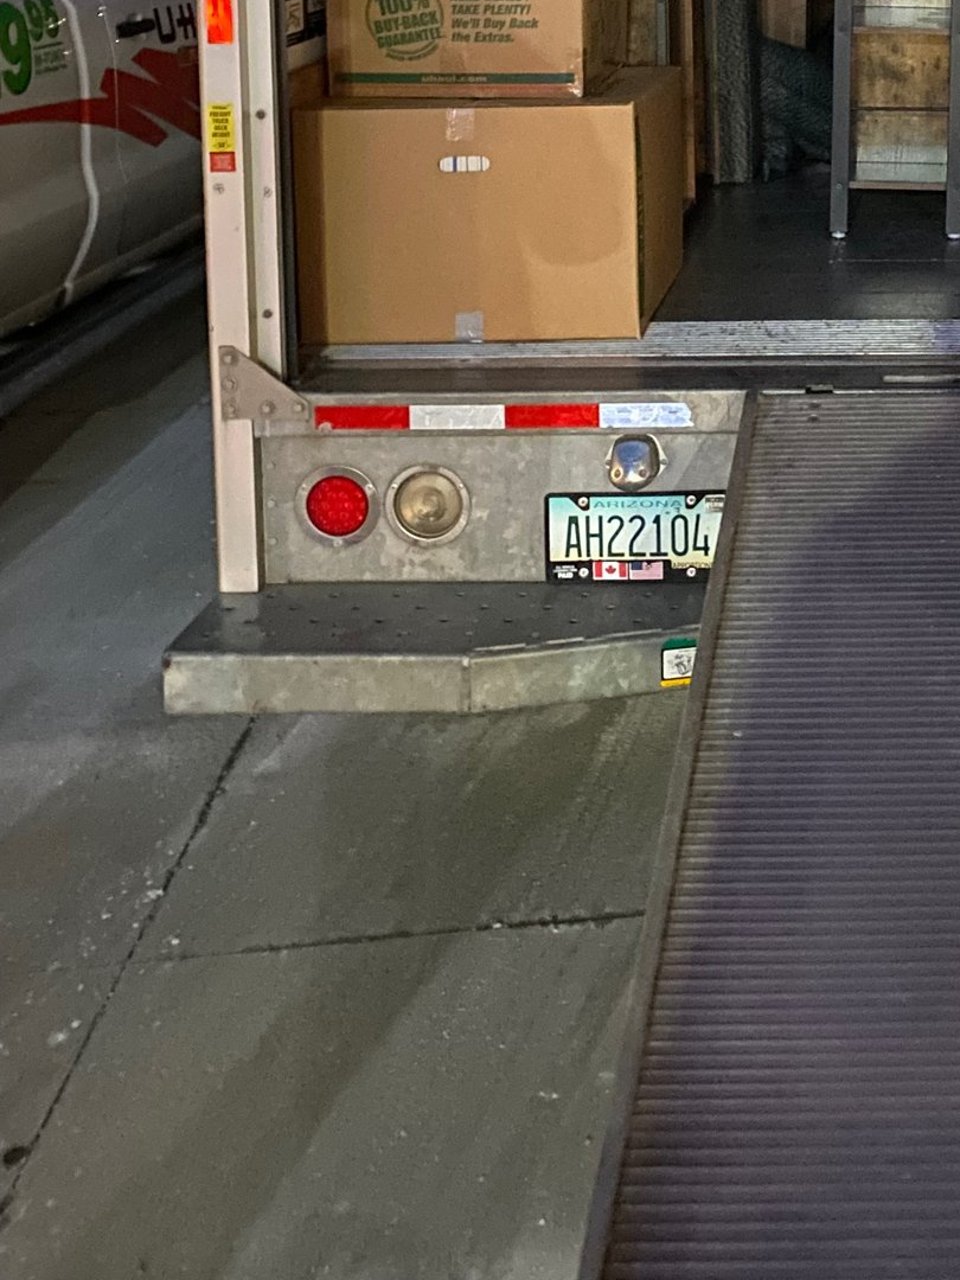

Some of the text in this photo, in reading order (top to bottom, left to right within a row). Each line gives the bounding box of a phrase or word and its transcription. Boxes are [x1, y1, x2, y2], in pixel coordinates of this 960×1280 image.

[451, 4, 531, 15] TAKE PLENTY!
[374, 10, 439, 35] BUY-BACK
[451, 18, 538, 31] We'll Buy Back
[377, 27, 442, 49] GUARANTEE
[451, 32, 514, 43] the Extras.
[593, 499, 683, 509] ARIZONA
[565, 513, 710, 558] AH22104
